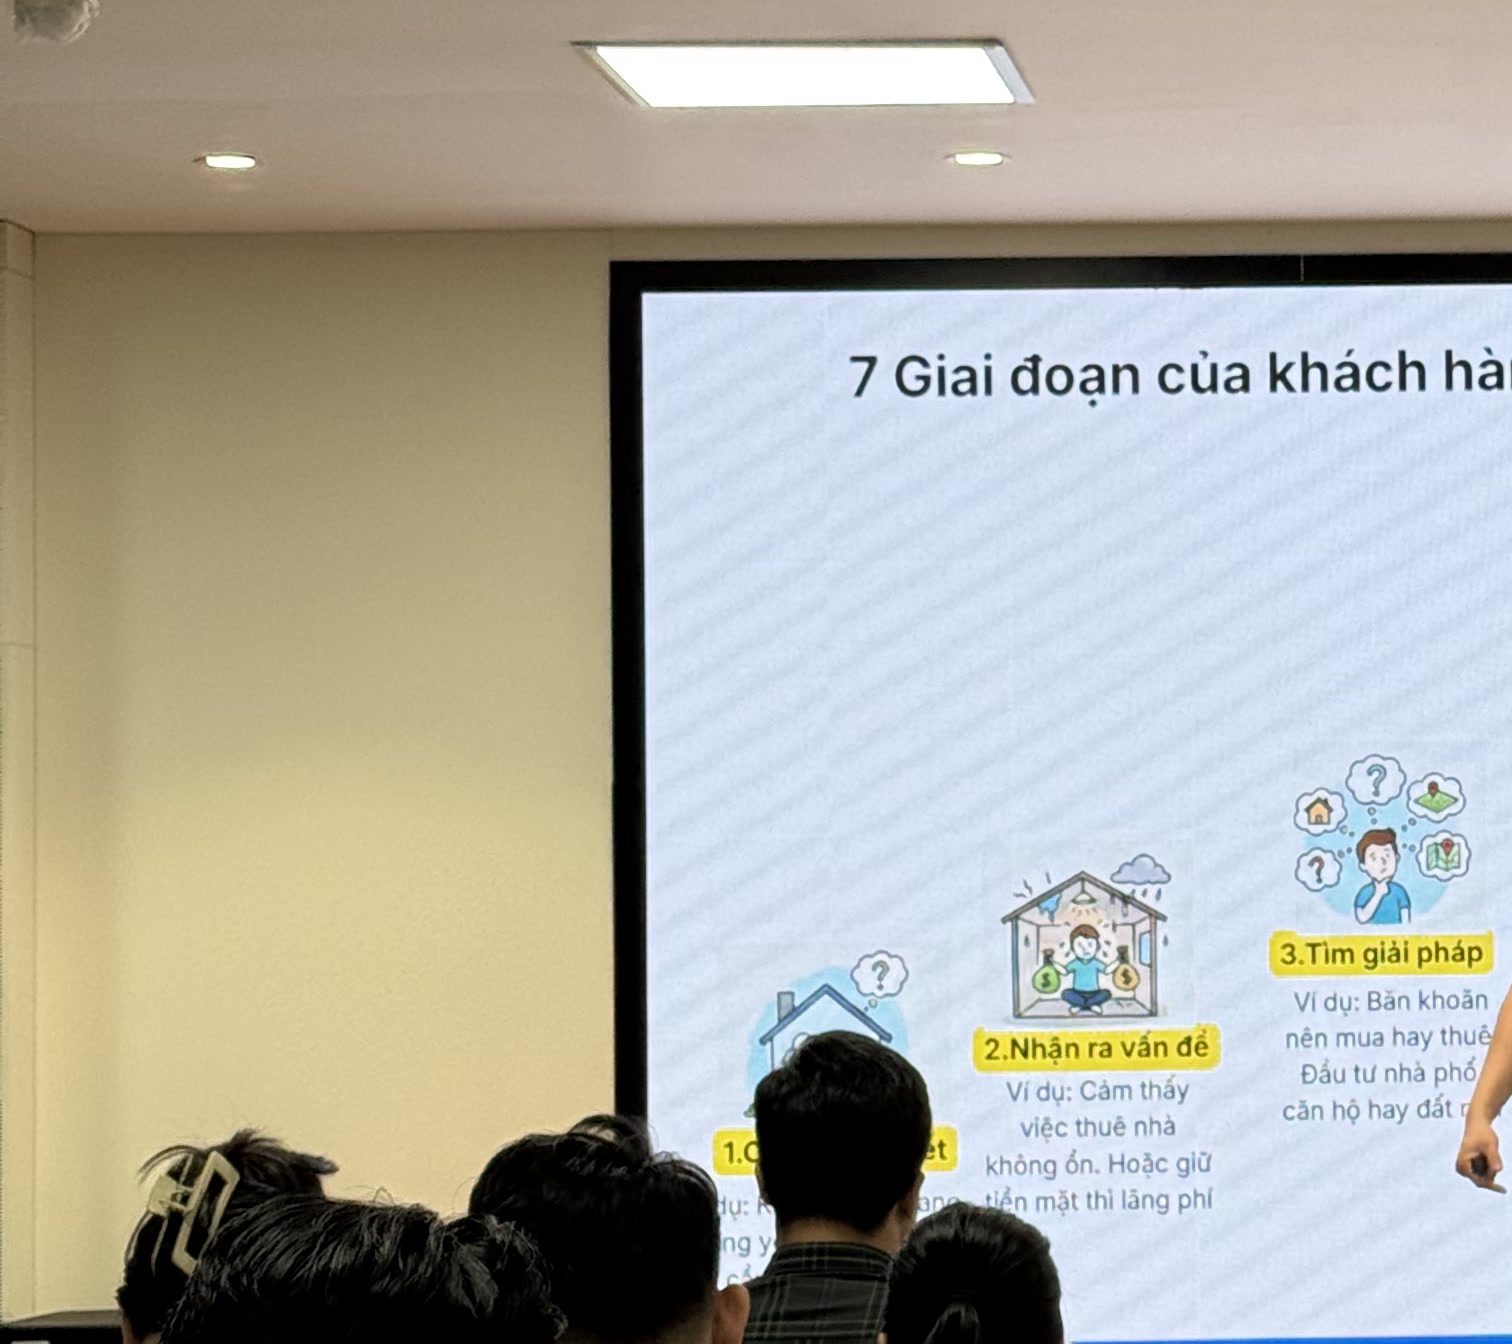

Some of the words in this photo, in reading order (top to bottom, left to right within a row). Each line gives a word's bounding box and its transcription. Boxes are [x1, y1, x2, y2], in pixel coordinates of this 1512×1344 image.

[849, 355, 878, 398] 7
[894, 352, 993, 398] Giai
[1009, 353, 1141, 408] đoạn
[1156, 350, 1252, 396] của
[1268, 348, 1427, 394] khách
[1279, 940, 1355, 966] 3.Tìm
[1362, 940, 1410, 971] giải
[1417, 939, 1484, 970] pháp
[1293, 990, 1317, 1014] Ví
[1323, 991, 1361, 1018] dụ:
[984, 1035, 1080, 1066] 2.Nhận
[1087, 1040, 1113, 1060] ra
[1120, 1029, 1168, 1059] vấn
[1176, 1028, 1210, 1058] đề
[1285, 1026, 1328, 1049] nên
[1335, 1031, 1385, 1049] mua
[1392, 1025, 1434, 1053] hay
[1353, 1063, 1378, 1085] tư
[1384, 1060, 1426, 1083] nhà
[1006, 1080, 1030, 1103] Ví
[1035, 1080, 1073, 1107] dụ:
[1079, 1078, 1133, 1102] Cảm
[1140, 1074, 1190, 1106] thấy
[1281, 1098, 1325, 1122] căn
[1332, 1098, 1361, 1126] hộ
[1368, 1098, 1409, 1126] hay
[1416, 1092, 1454, 1120] đất
[1019, 1115, 1069, 1144] việc
[1074, 1115, 1127, 1138] thuê
[1134, 1113, 1177, 1137] nhà
[985, 1152, 1057, 1181] không
[1108, 1152, 1169, 1180] Hoặc
[1175, 1150, 1213, 1179] giữ
[1035, 1189, 1080, 1217] mặt
[1085, 1188, 1114, 1212] thì
[1121, 1188, 1170, 1216] lãng
[1177, 1186, 1214, 1215] phí
